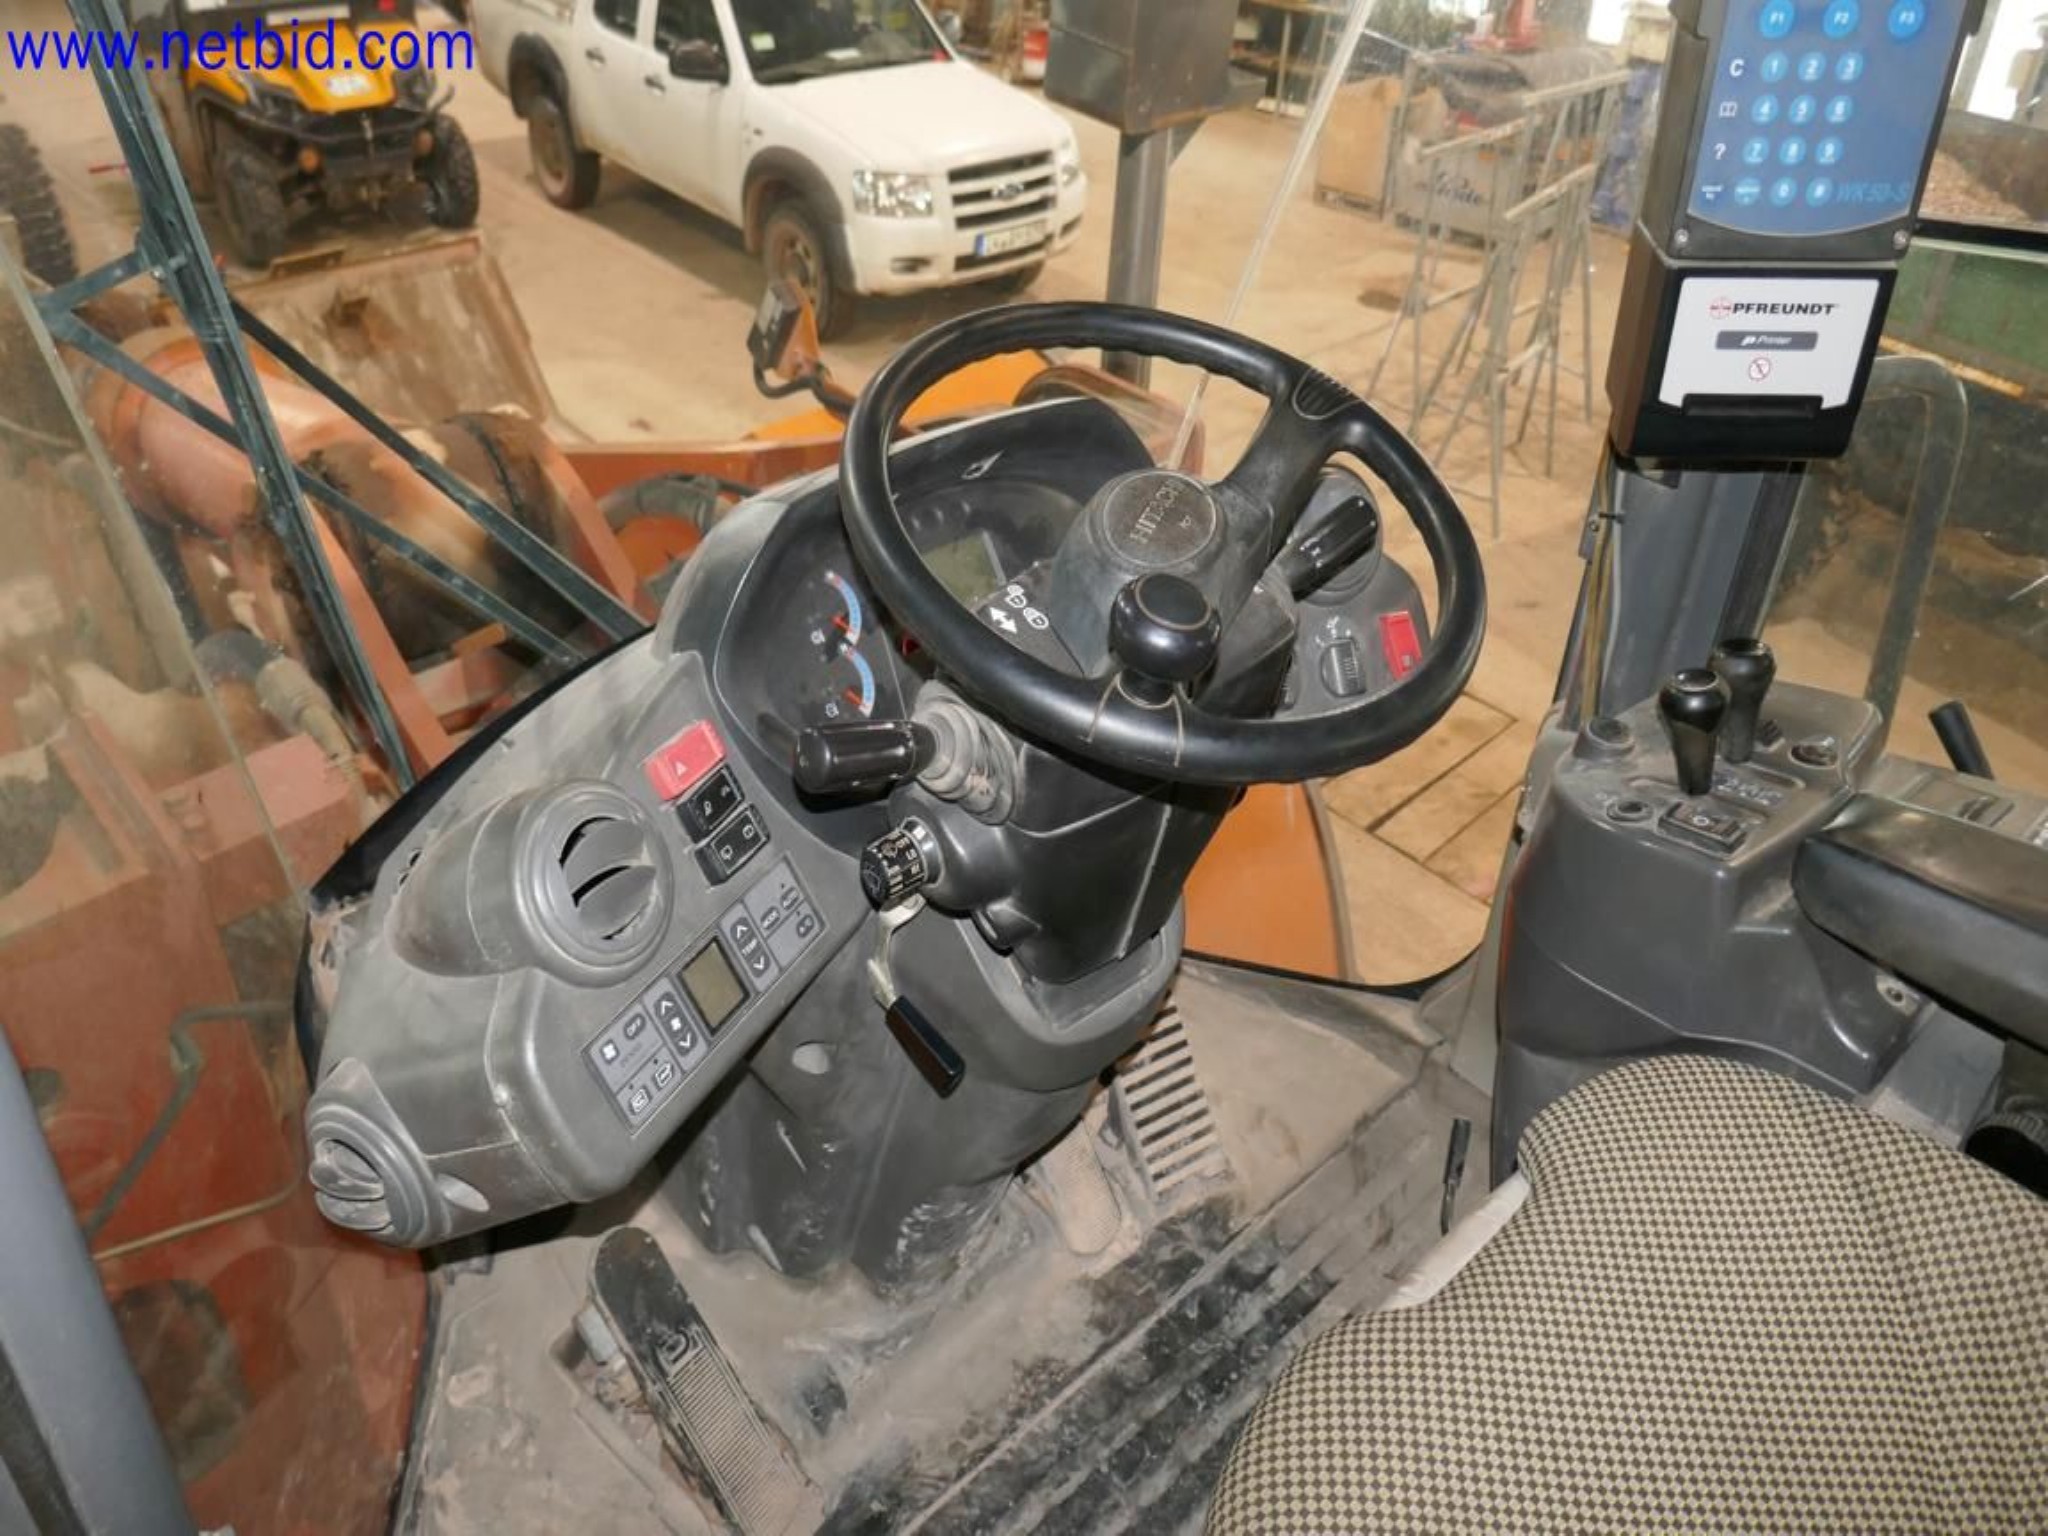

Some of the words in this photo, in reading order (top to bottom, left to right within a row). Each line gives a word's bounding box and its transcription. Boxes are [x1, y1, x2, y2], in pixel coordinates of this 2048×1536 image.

[1770, 11, 1785, 25] F1
[1834, 11, 1850, 25] F2
[1899, 10, 1916, 25] F3
[1729, 58, 1744, 77] C
[1770, 58, 1780, 75] 1
[1732, 302, 1836, 315] PFREUNDT
